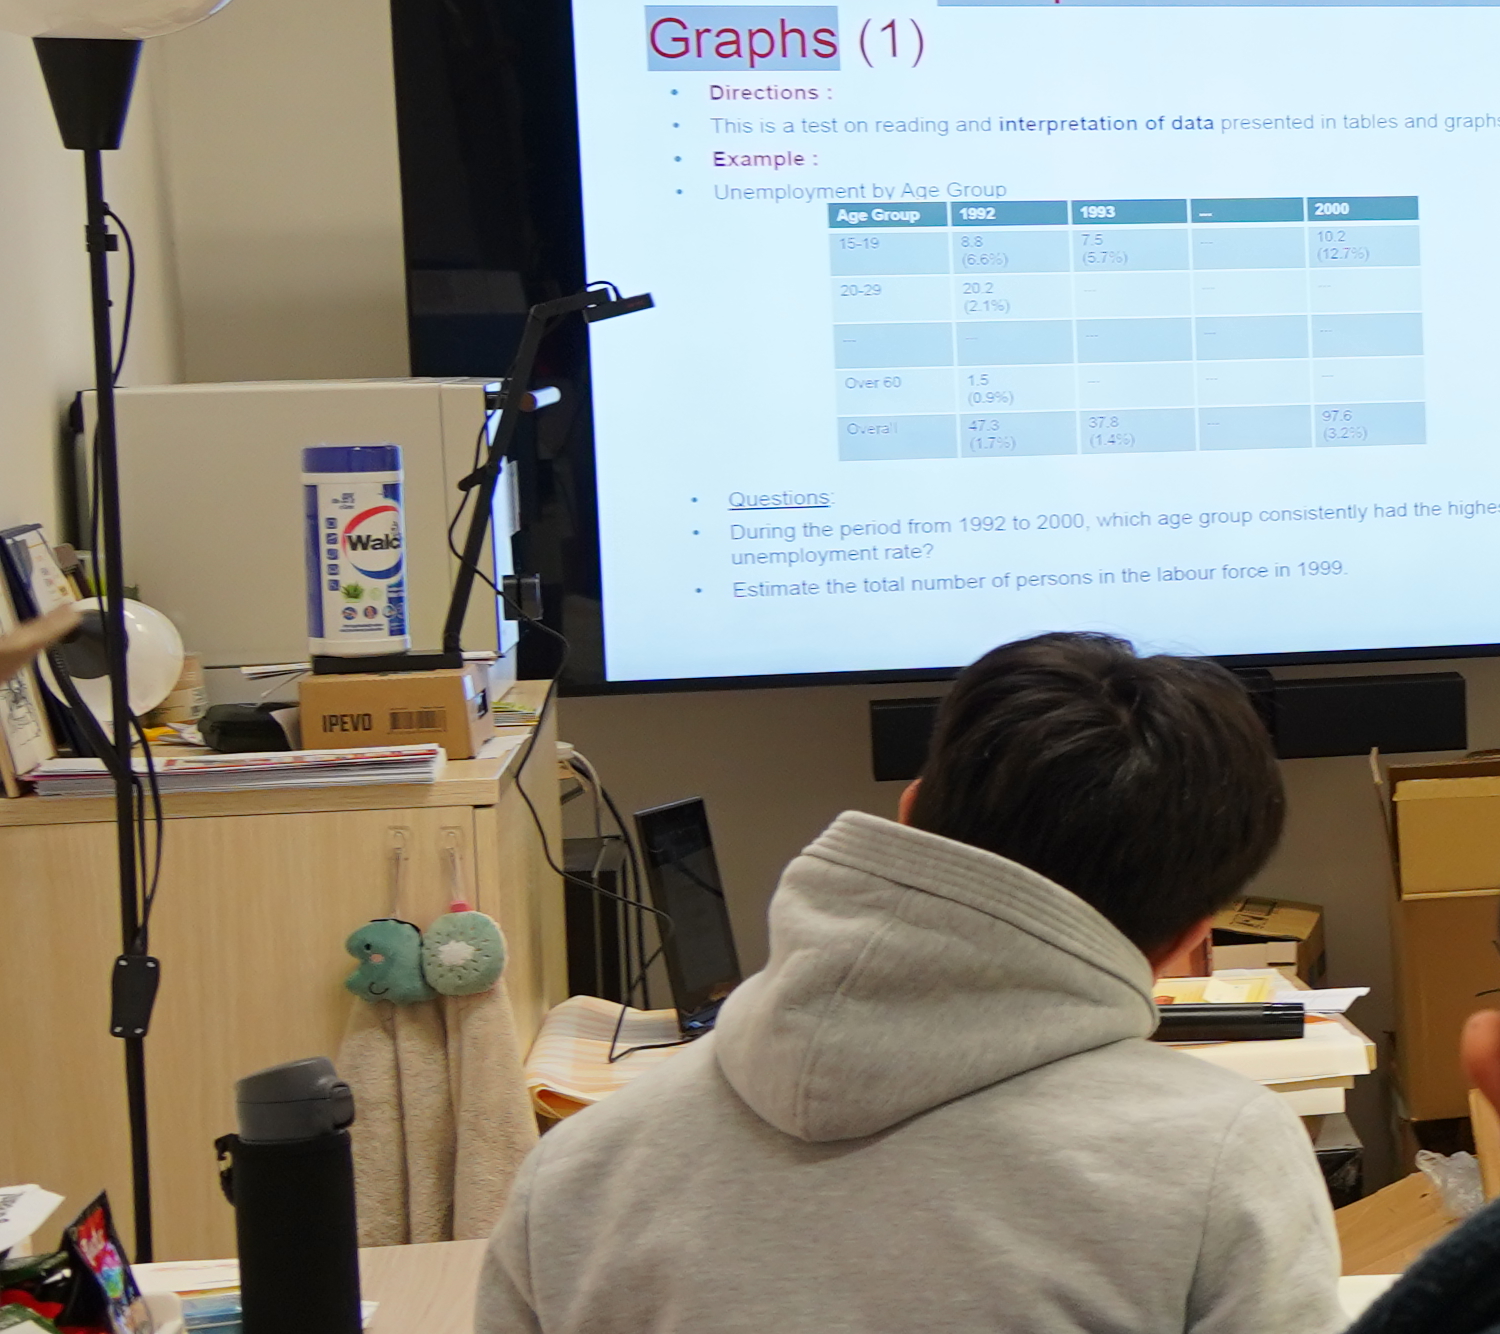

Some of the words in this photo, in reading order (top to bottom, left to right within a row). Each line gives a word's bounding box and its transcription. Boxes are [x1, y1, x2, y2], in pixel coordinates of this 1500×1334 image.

[650, 17, 838, 68] Graphs
[859, 18, 924, 68] (1)
[709, 85, 819, 101] Directions
[710, 118, 753, 134] This
[760, 118, 776, 133] is
[783, 120, 795, 133] a
[802, 118, 838, 133] test
[844, 120, 868, 133] on
[875, 117, 949, 136] reading
[956, 117, 992, 132] and
[999, 116, 1138, 135] interpretation
[1146, 116, 1165, 131] of
[1172, 115, 1214, 131] data
[1221, 115, 1314, 134] presented
[1321, 114, 1336, 130] in
[1343, 114, 1398, 130] tables
[1404, 113, 1438, 129] and
[713, 151, 805, 170] Example
[714, 183, 865, 203] Unemployment
[873, 182, 895, 201] by
[901, 183, 939, 200] Age
[946, 182, 1007, 200] Group
[837, 209, 868, 224] Age
[872, 208, 920, 223] Group
[959, 207, 996, 220] 1992
[1080, 206, 1116, 218] 1993
[1315, 203, 1350, 215] 2000
[839, 237, 880, 250] 15-19
[1082, 234, 1103, 246] 7.5
[1317, 231, 1346, 243] 10.2
[962, 252, 1009, 268] (6.6%)
[1083, 251, 1128, 266] (5.7%)
[1317, 247, 1370, 262] (12.7%)
[841, 284, 882, 296] 20-29
[963, 283, 994, 295] 20.2
[964, 299, 1010, 314] (2.1%)
[845, 377, 880, 389] Over
[883, 376, 902, 388] 60
[968, 374, 989, 386] 1.5
[968, 390, 1014, 406] (0.9%)
[1088, 416, 1119, 428] 37.8
[1322, 410, 1352, 422] 97.6
[847, 422, 898, 435] Overall
[968, 419, 1000, 431] 47.3
[728, 491, 835, 510] Questions:
[730, 523, 796, 542] During
[803, 523, 834, 538] the
[840, 520, 900, 540] period
[908, 519, 952, 535] from
[960, 516, 1006, 532] 1992
[1013, 516, 1030, 531] to
[1036, 514, 1090, 532] 2000,
[1096, 511, 1151, 528] which
[1158, 512, 1192, 530] age
[1199, 509, 1253, 530] group
[1259, 504, 1367, 524] consistently
[1374, 502, 1406, 518] had
[1414, 501, 1441, 517] the
[732, 546, 879, 567] unemployment
[884, 543, 934, 560] rate?
[733, 580, 820, 598] Estimate
[826, 579, 857, 595] the
[863, 576, 905, 593] total
[911, 574, 986, 592] number
[991, 573, 1010, 588] of
[1016, 570, 1092, 591] persons
[1099, 569, 1115, 585] in
[1122, 568, 1151, 583] the
[1157, 565, 1214, 582] labour
[1222, 563, 1268, 580] force
[1274, 562, 1290, 578] in
[1297, 560, 1348, 577] 1999.
[323, 713, 372, 732] IPEVO
